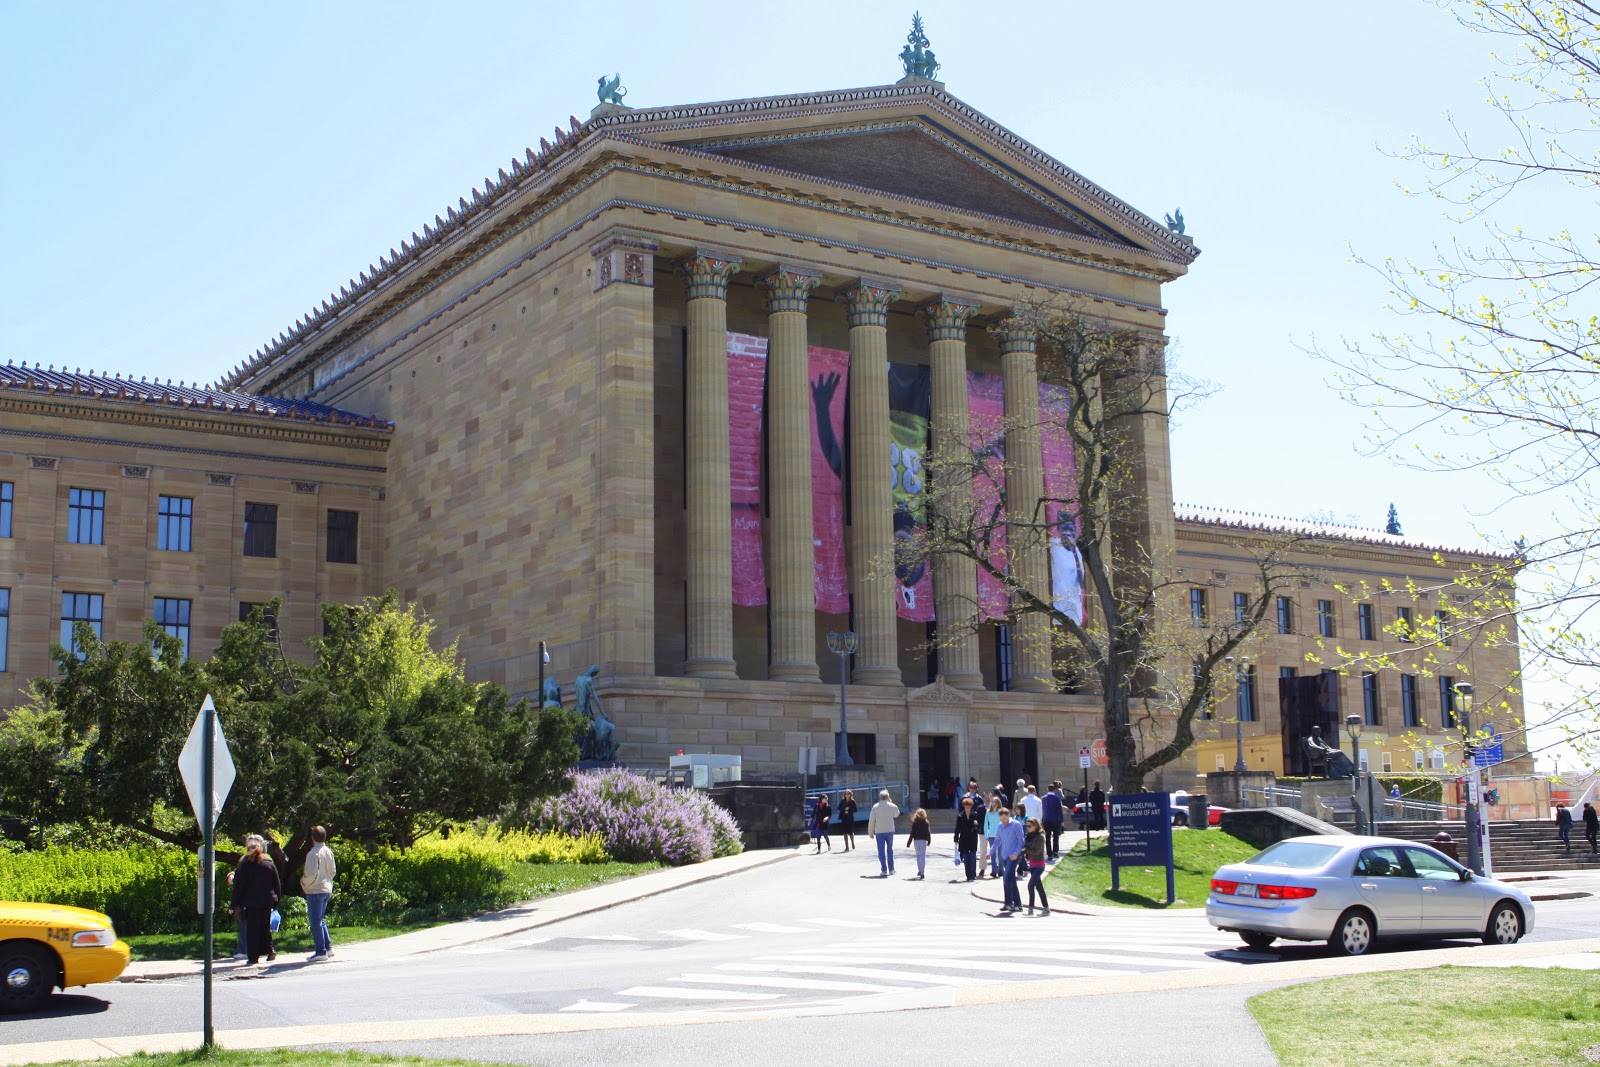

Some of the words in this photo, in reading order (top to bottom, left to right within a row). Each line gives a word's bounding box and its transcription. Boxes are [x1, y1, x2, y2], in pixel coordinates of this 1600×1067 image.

[1092, 747, 1106, 758] STO
[1121, 802, 1157, 810] PHILADELPHIA
[1121, 809, 1143, 817] MUSEUM
